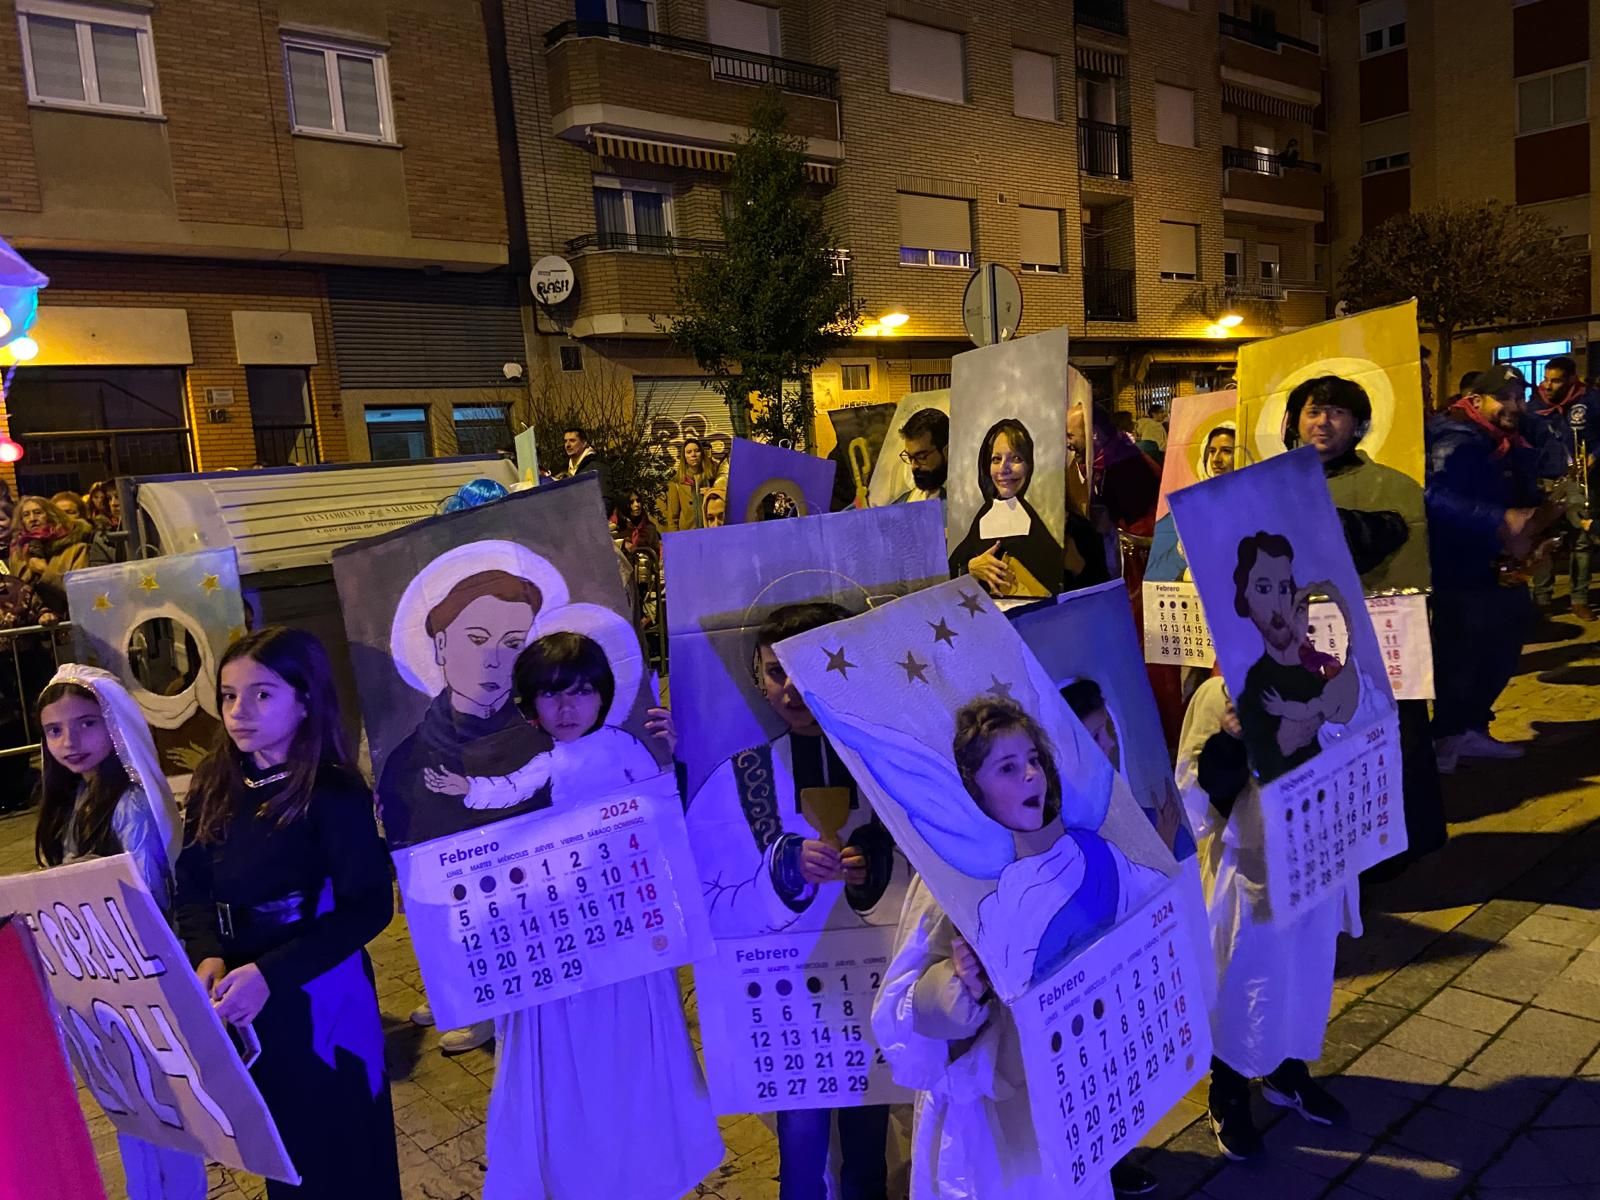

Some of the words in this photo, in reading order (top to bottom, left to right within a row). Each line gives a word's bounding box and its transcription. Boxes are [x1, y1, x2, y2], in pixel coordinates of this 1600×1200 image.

[1195, 602, 1198, 610] 1
[1370, 599, 1395, 608] 2024
[1160, 612, 1164, 620] 5
[1171, 613, 1176, 621] 6
[1183, 613, 1187, 621] 7
[1160, 624, 1168, 632] 12
[1171, 624, 1179, 633] 13
[1183, 625, 1191, 633] 14
[1195, 626, 1202, 634] 15
[1161, 635, 1169, 644] 19
[1172, 636, 1180, 645] 20
[1184, 636, 1192, 645] 21
[1195, 637, 1203, 646] 22
[1161, 646, 1169, 655] 26
[1173, 647, 1181, 655] 27
[1184, 648, 1193, 656] 28
[1197, 649, 1204, 658] 29
[1385, 634, 1397, 645] 11
[1389, 665, 1402, 676] 25
[600, 799, 639, 820] 2024
[1333, 819, 1342, 834] 15
[1347, 810, 1356, 824] 16
[1362, 800, 1371, 816] 17
[439, 841, 500, 866] Febrero
[542, 859, 550, 876] 1
[570, 851, 582, 868] 2
[598, 843, 610, 859] 3
[629, 833, 639, 850] 4
[459, 909, 470, 927] 5
[489, 901, 499, 918] 6
[517, 893, 526, 910] 7
[547, 885, 558, 902] 8
[576, 876, 587, 893] 9
[601, 866, 622, 887] 10
[631, 858, 649, 878] 11
[462, 933, 482, 952] 12
[490, 925, 510, 944] 13
[520, 916, 540, 936] 14
[549, 908, 569, 928] 15
[578, 900, 599, 919] 16
[608, 891, 625, 911] 17
[636, 883, 657, 903] 18
[1152, 900, 1174, 929] 2024
[468, 958, 487, 977] 19
[496, 951, 516, 971] 20
[526, 941, 545, 962] 21
[554, 934, 576, 954] 22
[585, 925, 605, 945] 23
[614, 916, 634, 937] 24
[642, 908, 664, 929] 25
[736, 948, 799, 962] Febrero
[474, 984, 495, 1003] 26
[503, 975, 521, 995] 27
[532, 968, 553, 987] 28
[561, 959, 582, 979] 29
[840, 974, 848, 991] 1
[870, 972, 880, 989] 2
[1116, 984, 1122, 1003] 1
[1133, 969, 1141, 989] 2
[1152, 955, 1159, 975] 3
[1169, 941, 1174, 958] 4
[1039, 970, 1086, 1012] Febrero
[752, 1008, 762, 1023] 5
[782, 1005, 792, 1021] 6
[812, 1003, 821, 1019] 7
[843, 1000, 853, 1016] 8
[751, 1032, 771, 1048] 12
[781, 1030, 801, 1046] 13
[811, 1027, 831, 1044] 14
[842, 1025, 862, 1042] 15
[1056, 1063, 1065, 1085] 5
[1079, 1046, 1088, 1068] 6
[1099, 1029, 1107, 1050] 7
[1121, 1014, 1128, 1034] 8
[1138, 999, 1145, 1018] 9
[1153, 982, 1165, 1005] 10
[1171, 967, 1182, 989] 11
[754, 1056, 774, 1073] 19
[784, 1054, 804, 1070] 20
[815, 1052, 833, 1068] 21
[845, 1050, 865, 1067] 22
[875, 1048, 886, 1064] 2
[1060, 1092, 1074, 1119] 12
[1081, 1074, 1096, 1100] 13
[1102, 1056, 1117, 1083] 14
[1123, 1040, 1136, 1066] 15
[1141, 1025, 1153, 1049] 16
[1158, 1009, 1168, 1033] 17
[1174, 995, 1186, 1017] 18
[757, 1081, 777, 1098] 26
[787, 1078, 806, 1095] 27
[817, 1077, 838, 1093] 28
[848, 1075, 868, 1092] 29
[1066, 1123, 1079, 1150] 19
[1085, 1105, 1100, 1133] 20
[1107, 1087, 1122, 1114] 21
[1127, 1070, 1141, 1097] 22
[1146, 1054, 1159, 1080] 23
[1163, 1037, 1175, 1063] 24
[1179, 1022, 1192, 1047] 25
[1072, 1154, 1086, 1184] 26
[1090, 1135, 1103, 1163] 27
[1111, 1117, 1127, 1144] 28
[1132, 1100, 1144, 1126] 29
